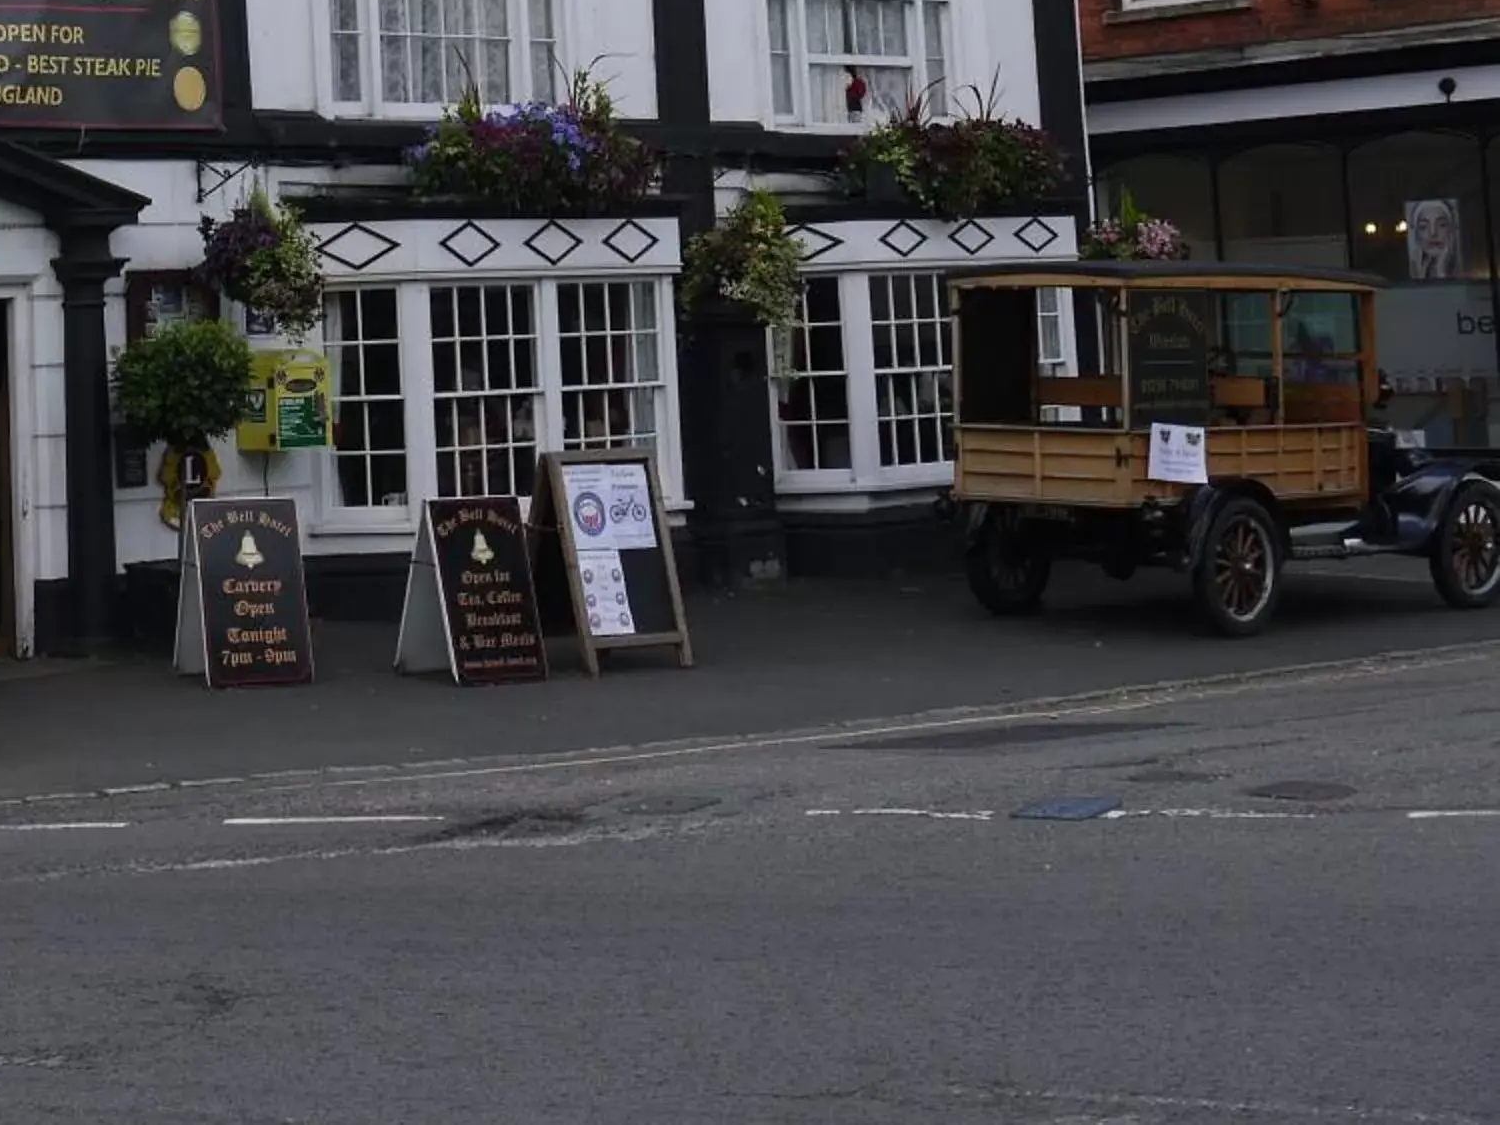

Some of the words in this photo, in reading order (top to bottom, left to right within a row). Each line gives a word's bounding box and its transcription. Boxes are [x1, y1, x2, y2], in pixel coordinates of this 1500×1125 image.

[51, 26, 84, 44] FOR
[27, 54, 71, 75] BEST
[73, 56, 131, 76] STEAK
[136, 58, 163, 77] PIE
[458, 507, 483, 522] Bell
[201, 520, 225, 539] The
[226, 510, 254, 524] Bell
[259, 512, 293, 538] Hotel
[222, 578, 283, 595] Carvery
[461, 570, 493, 585] Open
[486, 591, 522, 604] Coffee
[233, 599, 275, 617] Open
[227, 626, 288, 644] Tonight
[459, 635, 472, 650] &
[500, 633, 536, 647] Meals
[221, 650, 253, 667] 7pm
[264, 648, 297, 665] 9pm
